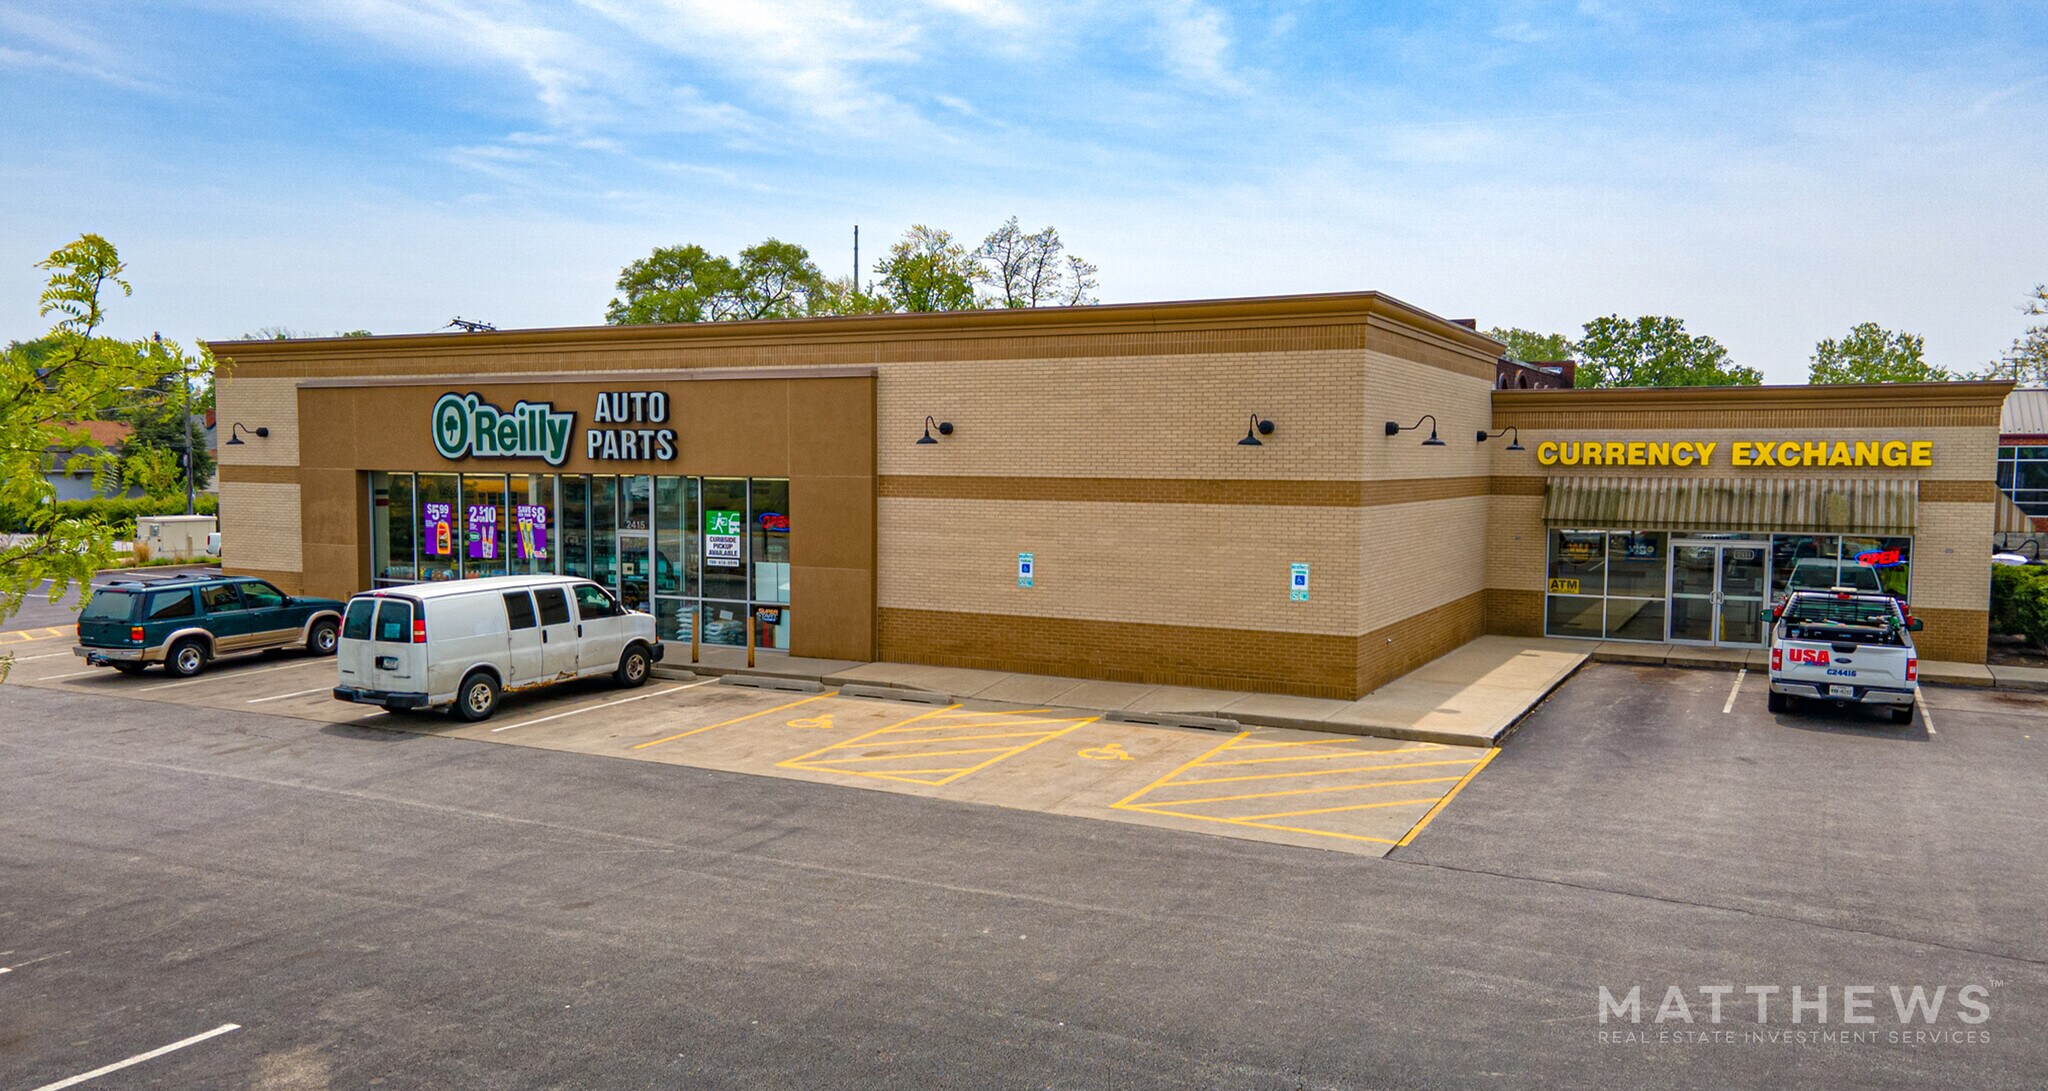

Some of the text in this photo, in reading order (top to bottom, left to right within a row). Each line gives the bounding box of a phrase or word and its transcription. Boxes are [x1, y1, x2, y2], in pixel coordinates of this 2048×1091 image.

[594, 391, 667, 423] AUTO
[435, 393, 572, 462] O'Reilly
[587, 429, 675, 462] PARTS
[1537, 440, 1933, 467] CURRENCY EXCHANGE
[469, 506, 477, 522] 2
[531, 507, 546, 523] $8
[626, 521, 645, 530] 2415
[708, 549, 738, 557] AVAILABLE
[1859, 550, 1901, 567] OPEN
[1551, 579, 1577, 590] ATM
[1789, 648, 1830, 663] USA
